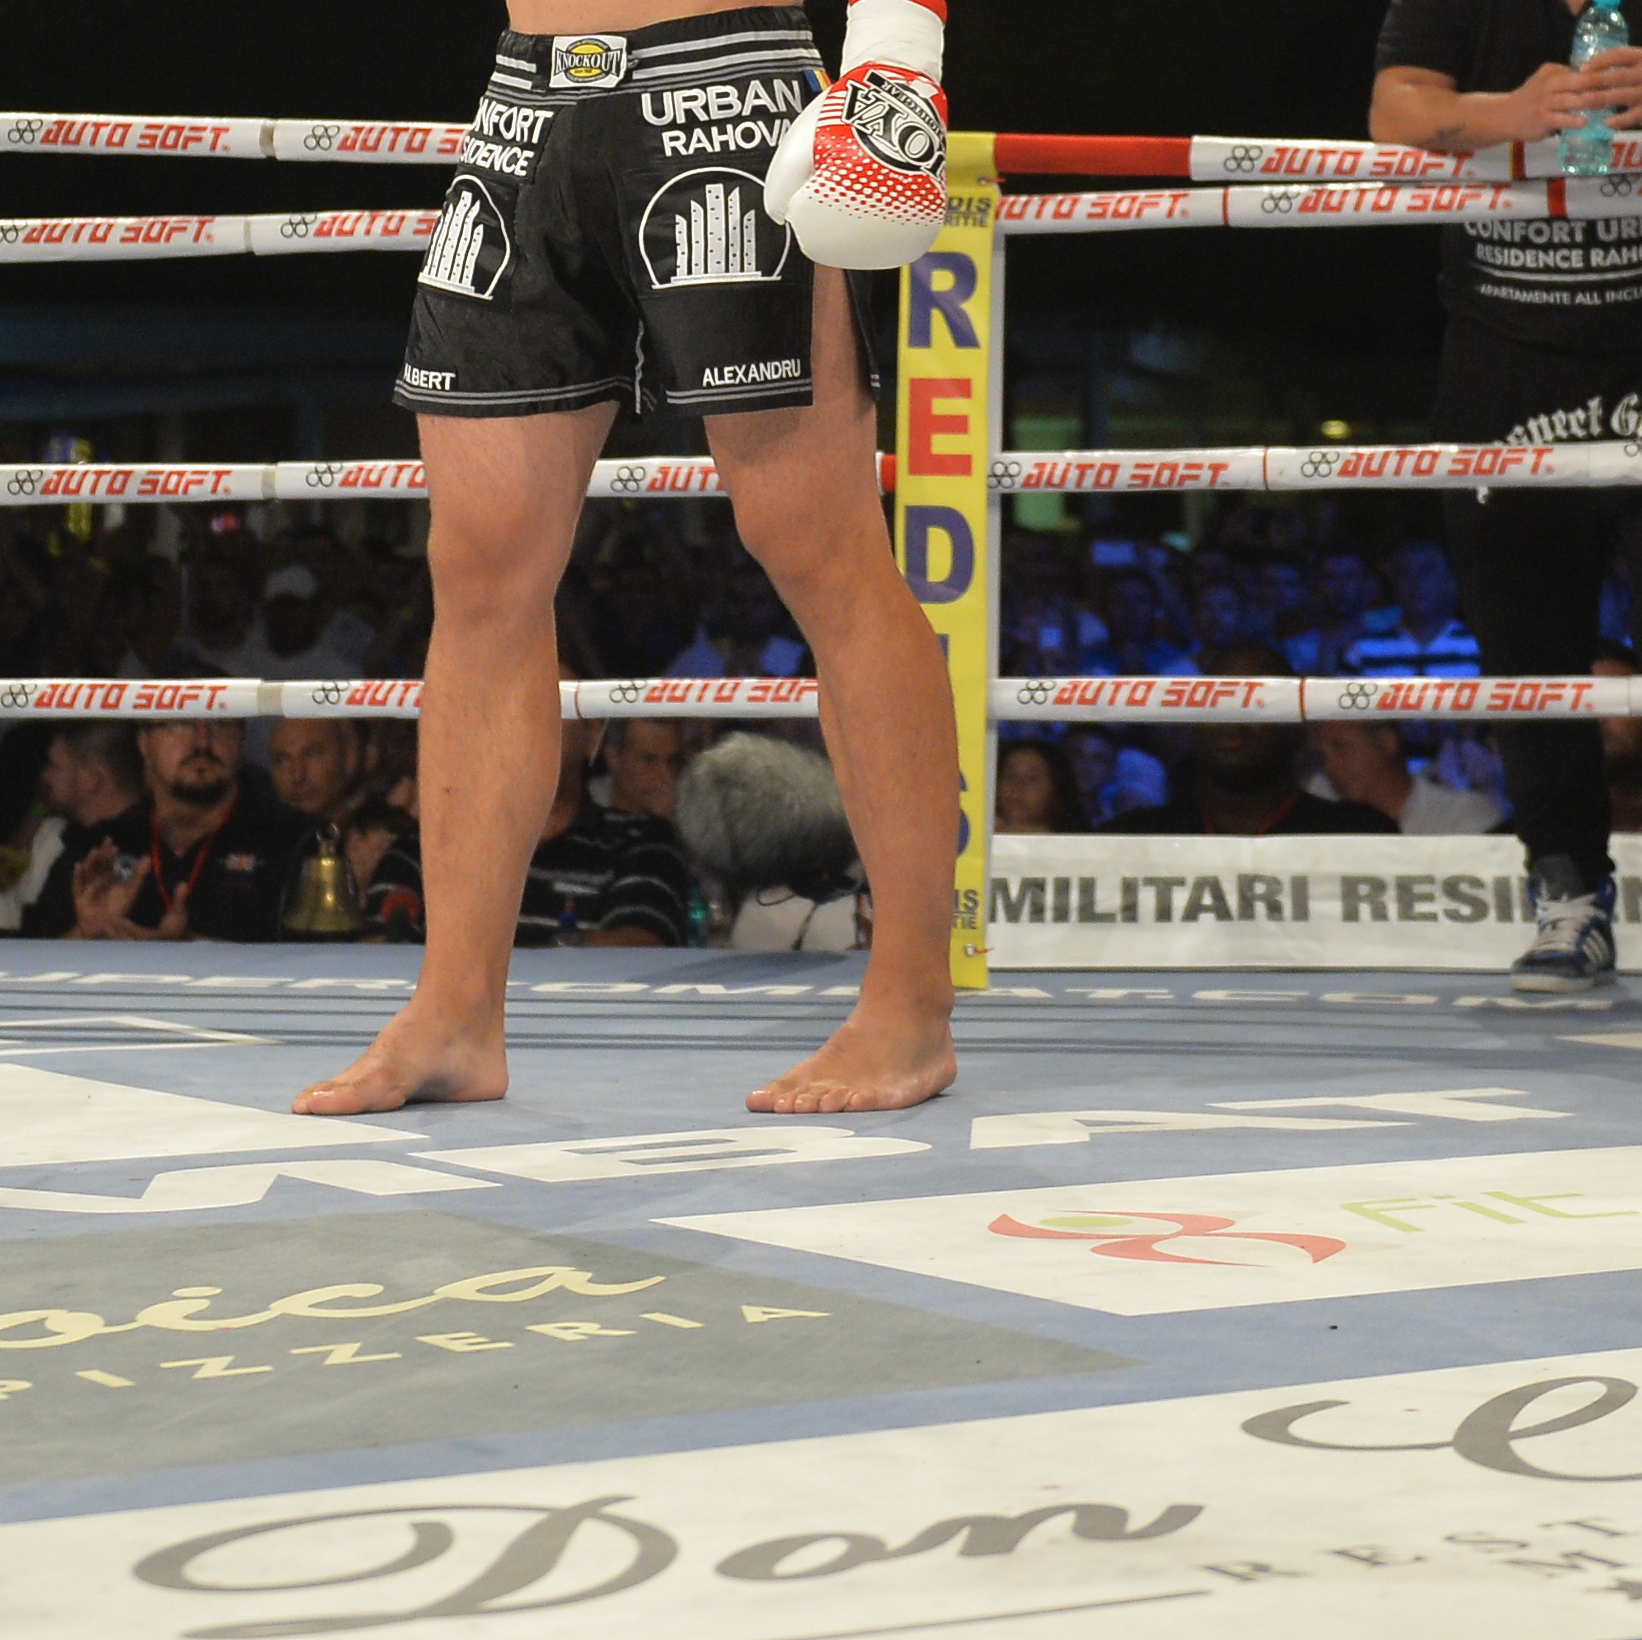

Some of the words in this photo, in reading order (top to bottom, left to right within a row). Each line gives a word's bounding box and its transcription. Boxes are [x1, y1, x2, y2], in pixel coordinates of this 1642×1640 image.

[556, 49, 622, 76] KNOCKOUT
[641, 79, 802, 126] URBAN
[472, 95, 555, 145] NFORT
[1477, 243, 1584, 269] RESIDENCE
[1575, 290, 1602, 306] ALL
[403, 363, 456, 391] ALBERT
[702, 359, 801, 388] ALEXANDRU
[649, 465, 719, 491] AUT
[347, 681, 422, 707] AUT
[748, 678, 818, 703] SOF
[990, 874, 1310, 924] MILITARI
[132, 1493, 1205, 1640] Don
